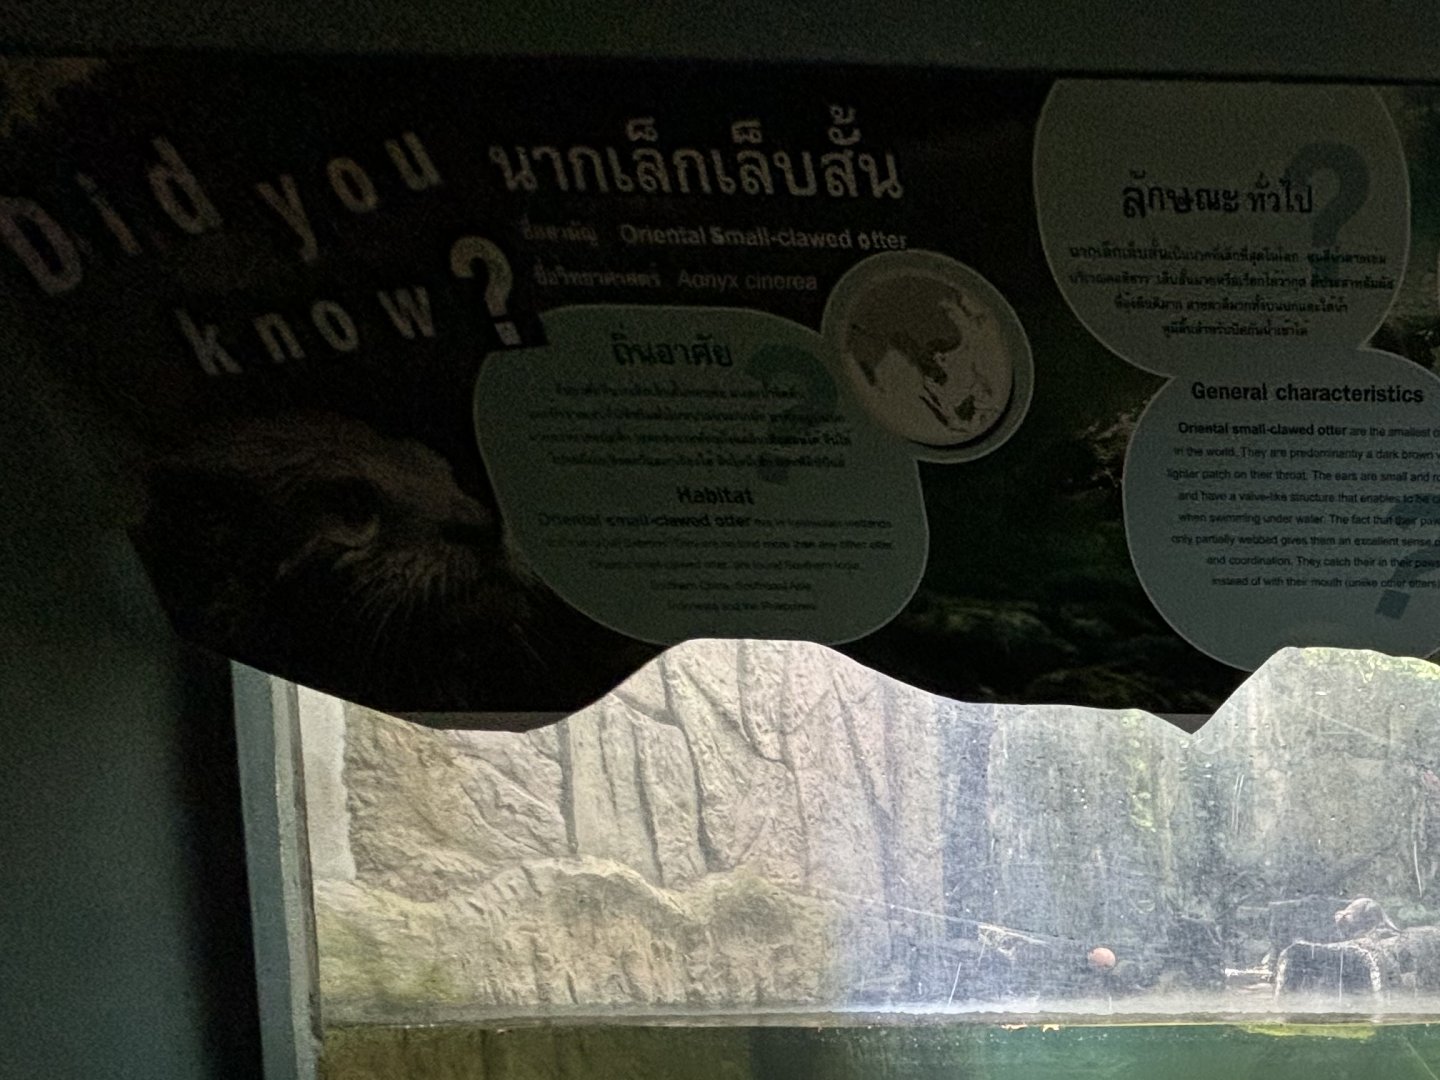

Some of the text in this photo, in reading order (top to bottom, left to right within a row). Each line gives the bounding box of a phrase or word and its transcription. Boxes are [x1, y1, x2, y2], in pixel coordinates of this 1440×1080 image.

[488, 103, 903, 200] นากเล็กเล็บสั้น
[0, 130, 444, 297] Did you
[618, 222, 706, 246] Oriental
[857, 230, 907, 251] otter
[1191, 381, 1424, 403] General characteristics
[1178, 421, 1229, 434] Oriental
[1232, 423, 1314, 436] small-clawed
[1317, 425, 1347, 436] otter
[676, 486, 754, 505] Habitat
